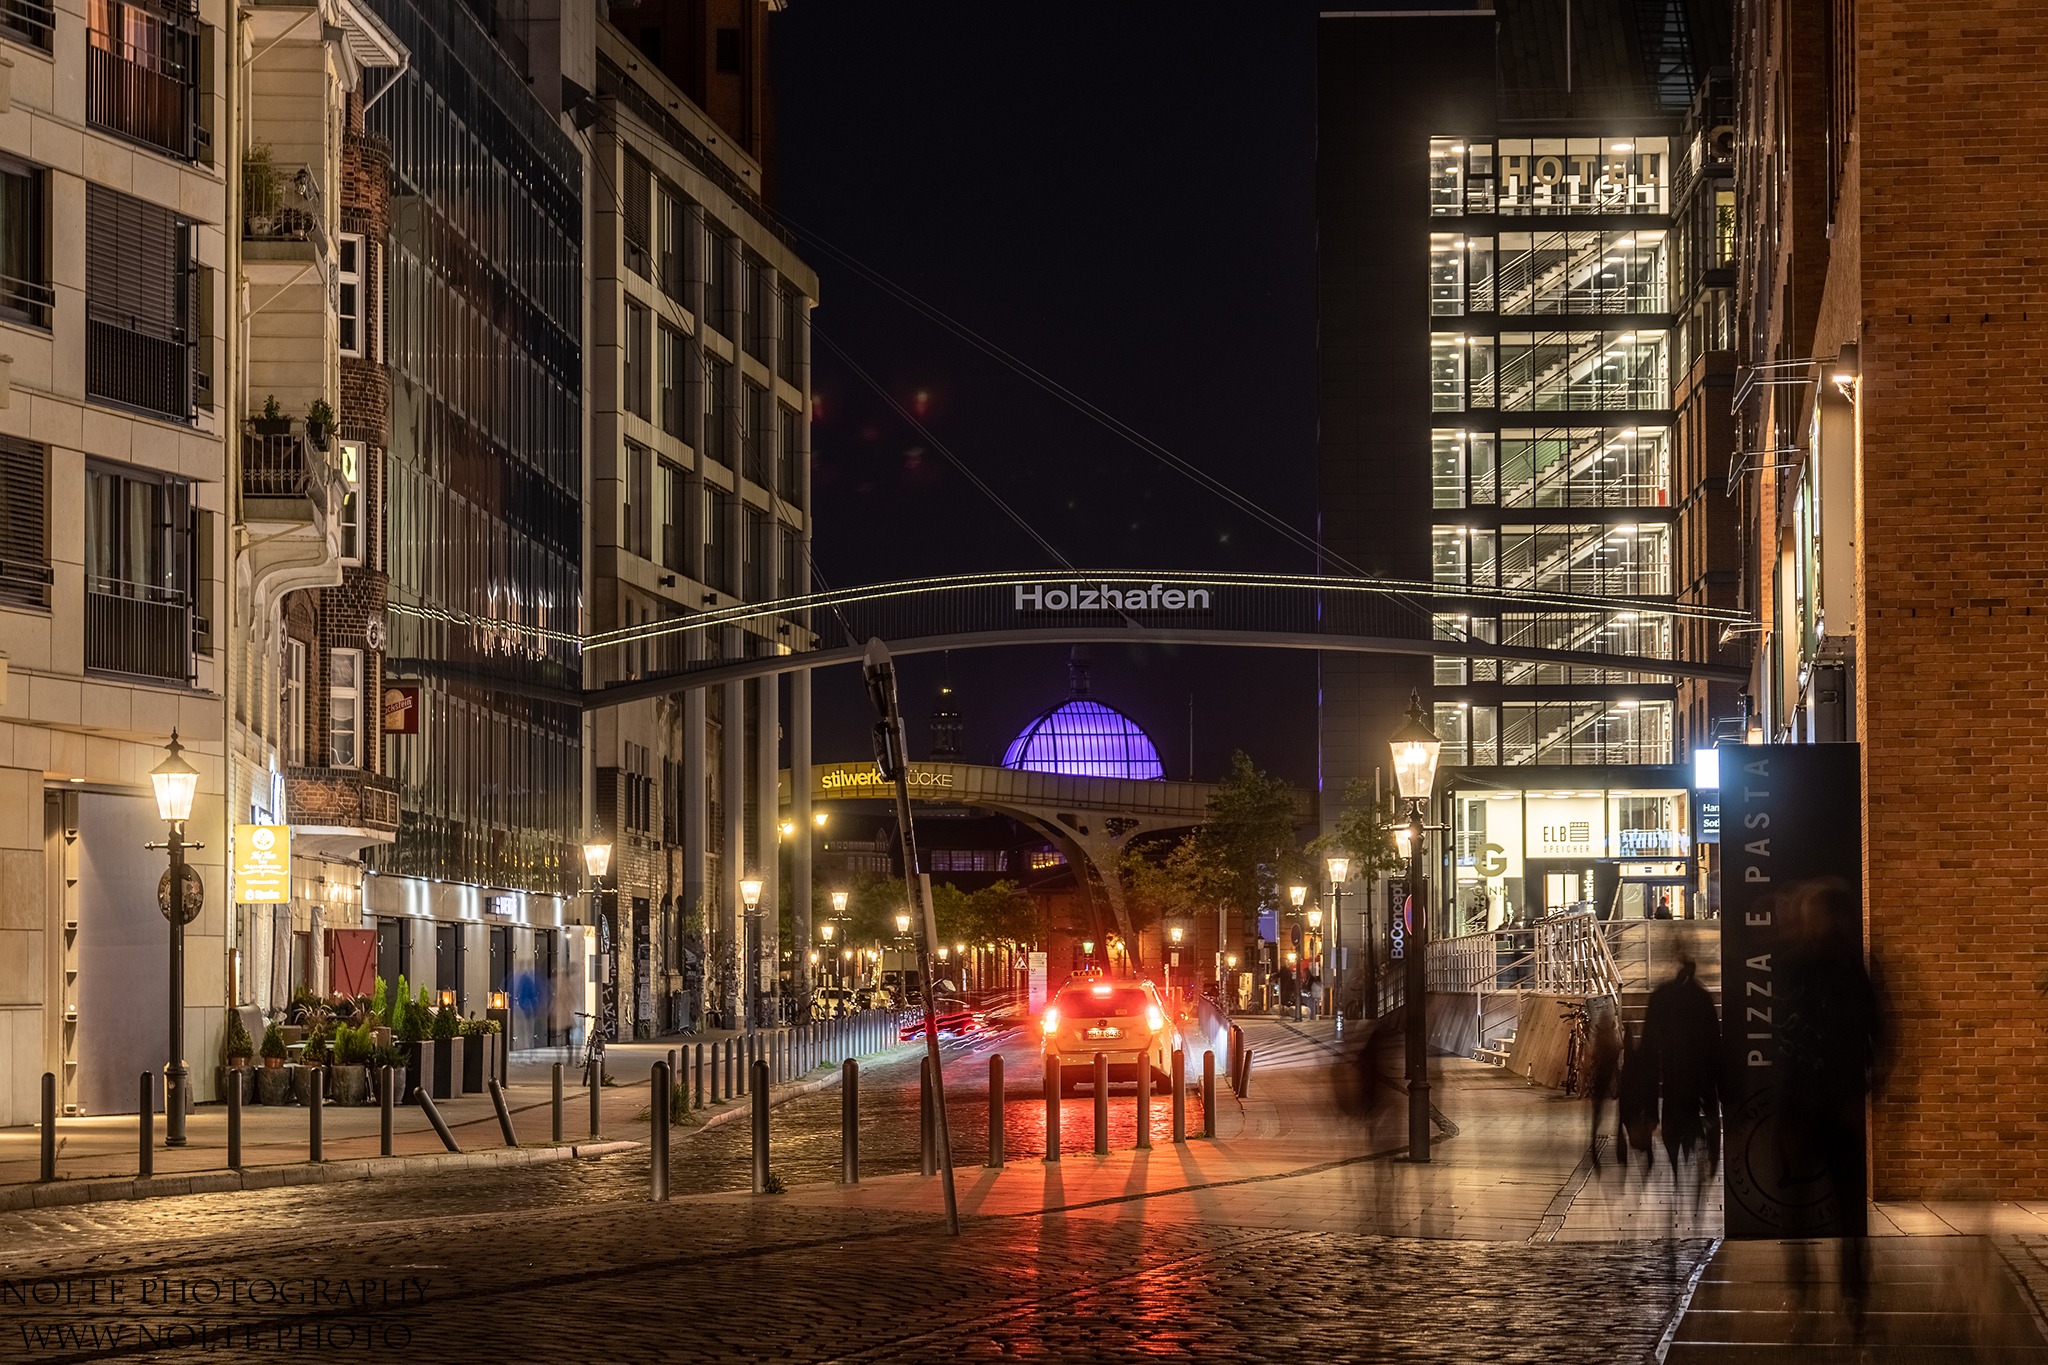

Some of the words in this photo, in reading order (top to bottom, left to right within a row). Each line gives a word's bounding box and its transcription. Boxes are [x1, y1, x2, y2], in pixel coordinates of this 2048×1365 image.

[1502, 155, 1660, 187] HOTEL
[1015, 583, 1210, 610] Holzhafen
[1543, 826, 1567, 842] ELB
[1743, 758, 1770, 883] PASTA
[1474, 842, 1508, 877] G
[1543, 845, 1590, 853] SPEICHER
[1473, 885, 1509, 896] GINN
[1390, 882, 1406, 959] BoConcept
[1745, 911, 1771, 926] E
[1746, 953, 1773, 1067] PIZZA
